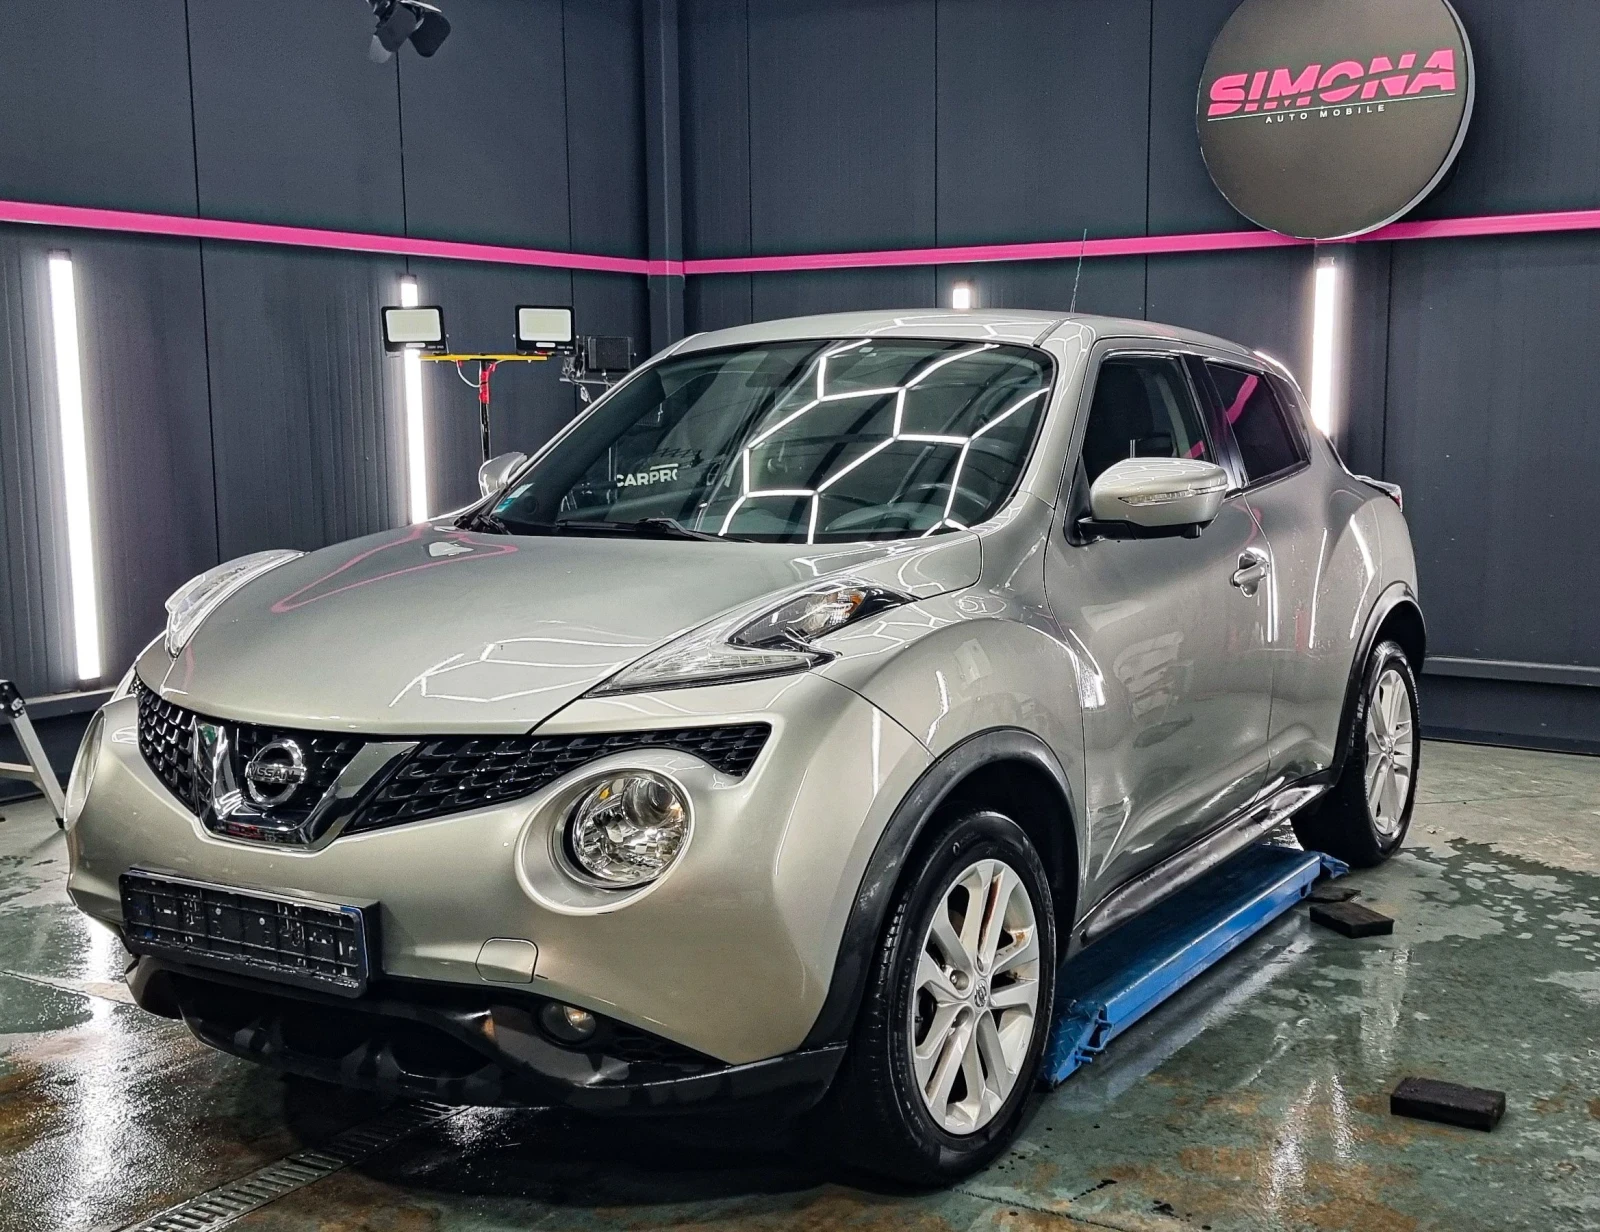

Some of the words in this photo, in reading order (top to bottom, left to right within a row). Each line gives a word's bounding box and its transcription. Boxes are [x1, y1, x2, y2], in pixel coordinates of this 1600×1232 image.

[1207, 49, 1456, 116] SIMONA
[1265, 111, 1308, 124] AUTO
[1319, 104, 1386, 118] MOBILE
[249, 763, 295, 781] NISSAN
